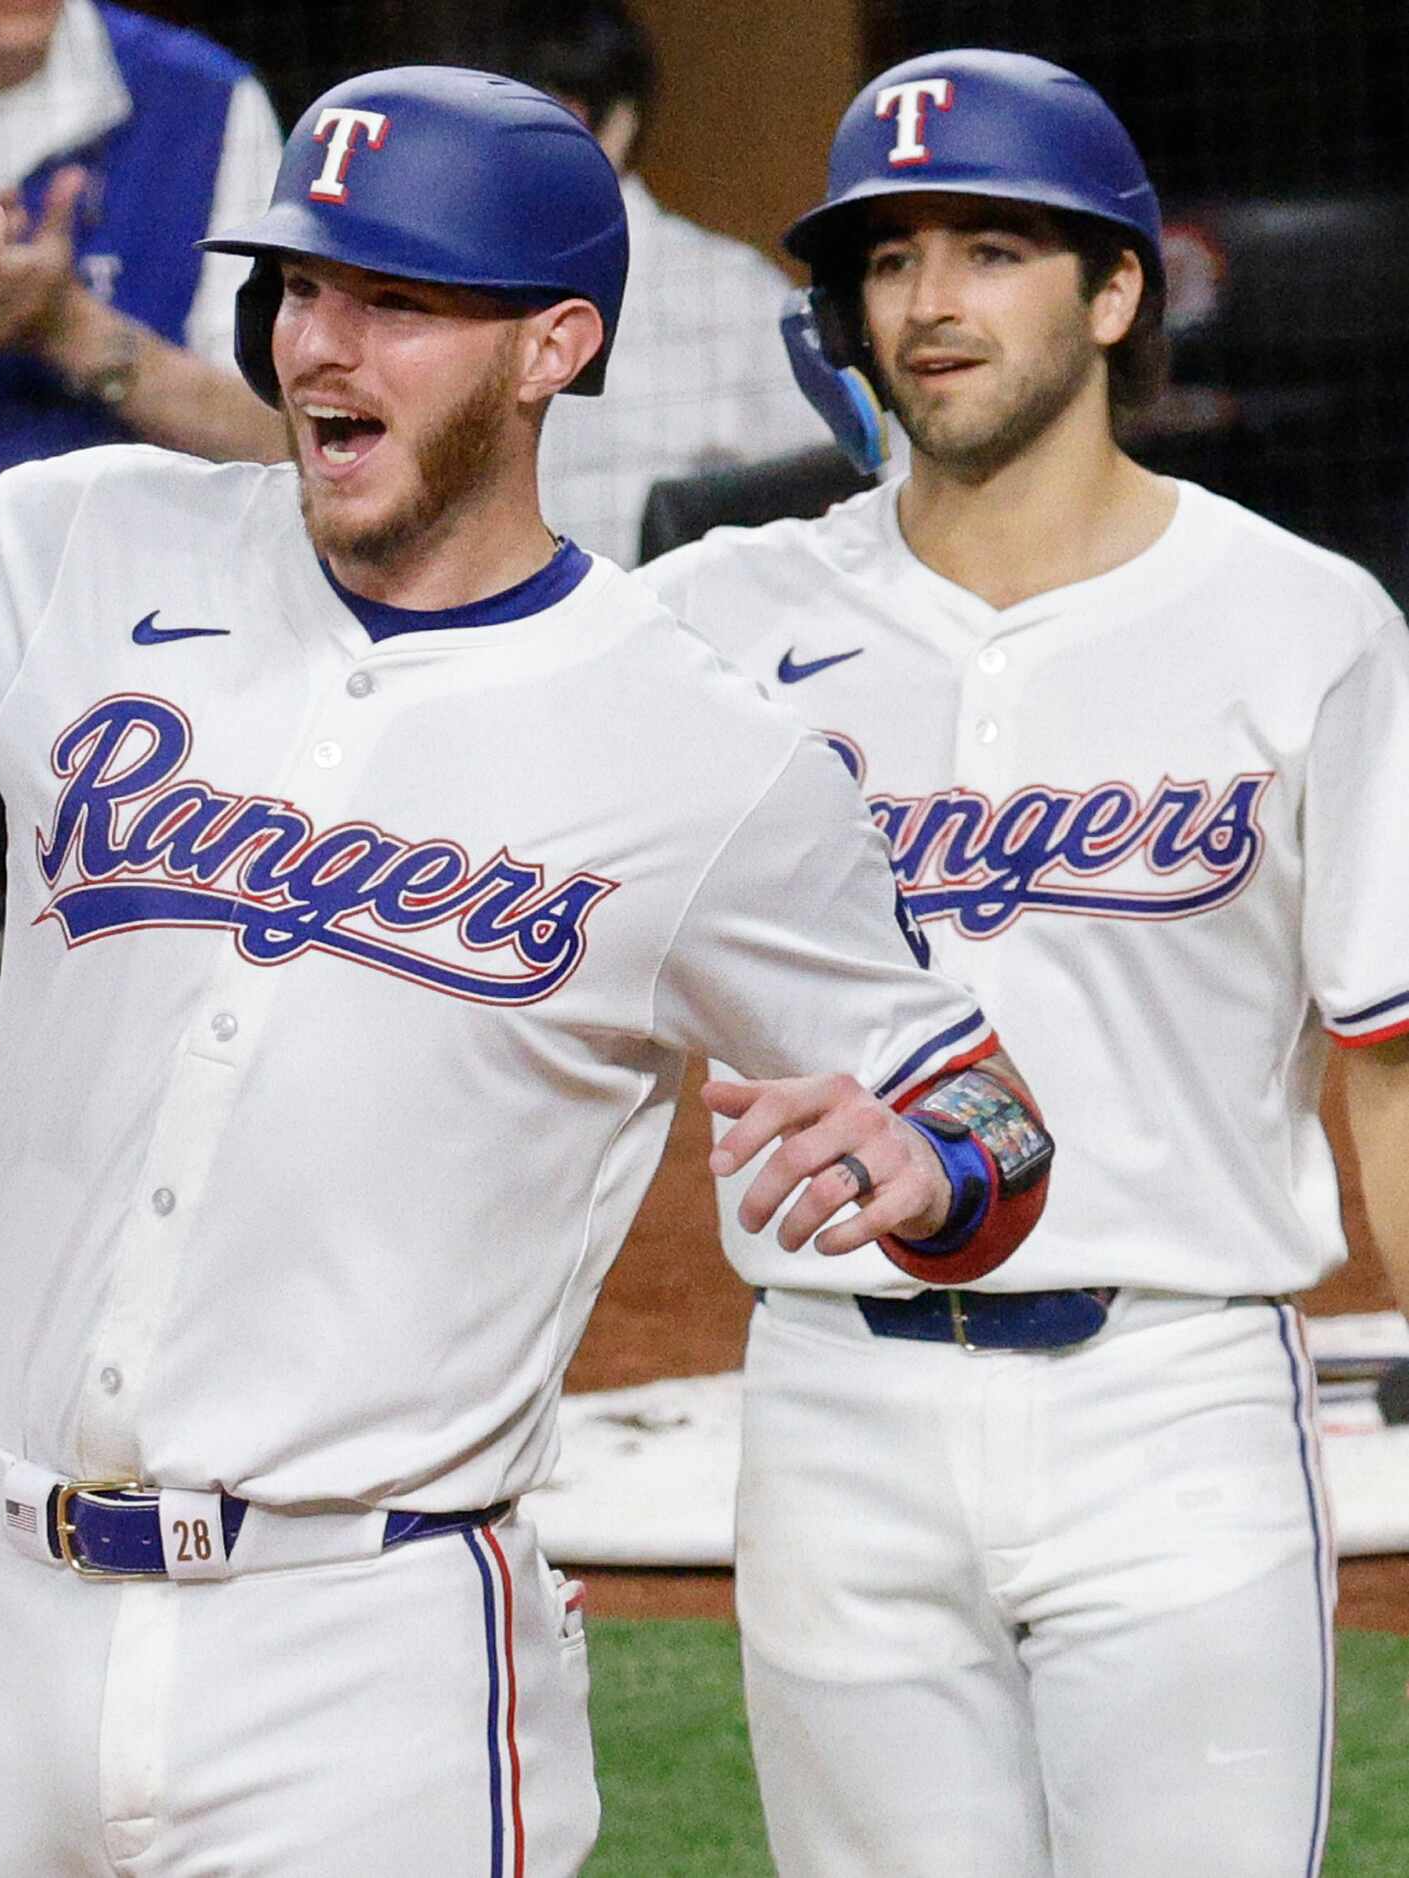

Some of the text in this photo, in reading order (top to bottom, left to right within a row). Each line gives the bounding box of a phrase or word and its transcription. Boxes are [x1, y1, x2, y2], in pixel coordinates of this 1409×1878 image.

[311, 107, 391, 205] T
[875, 78, 953, 168] T
[33, 692, 621, 1006] Rangers
[812, 729, 1276, 941] angers
[172, 1518, 212, 1562] 28
